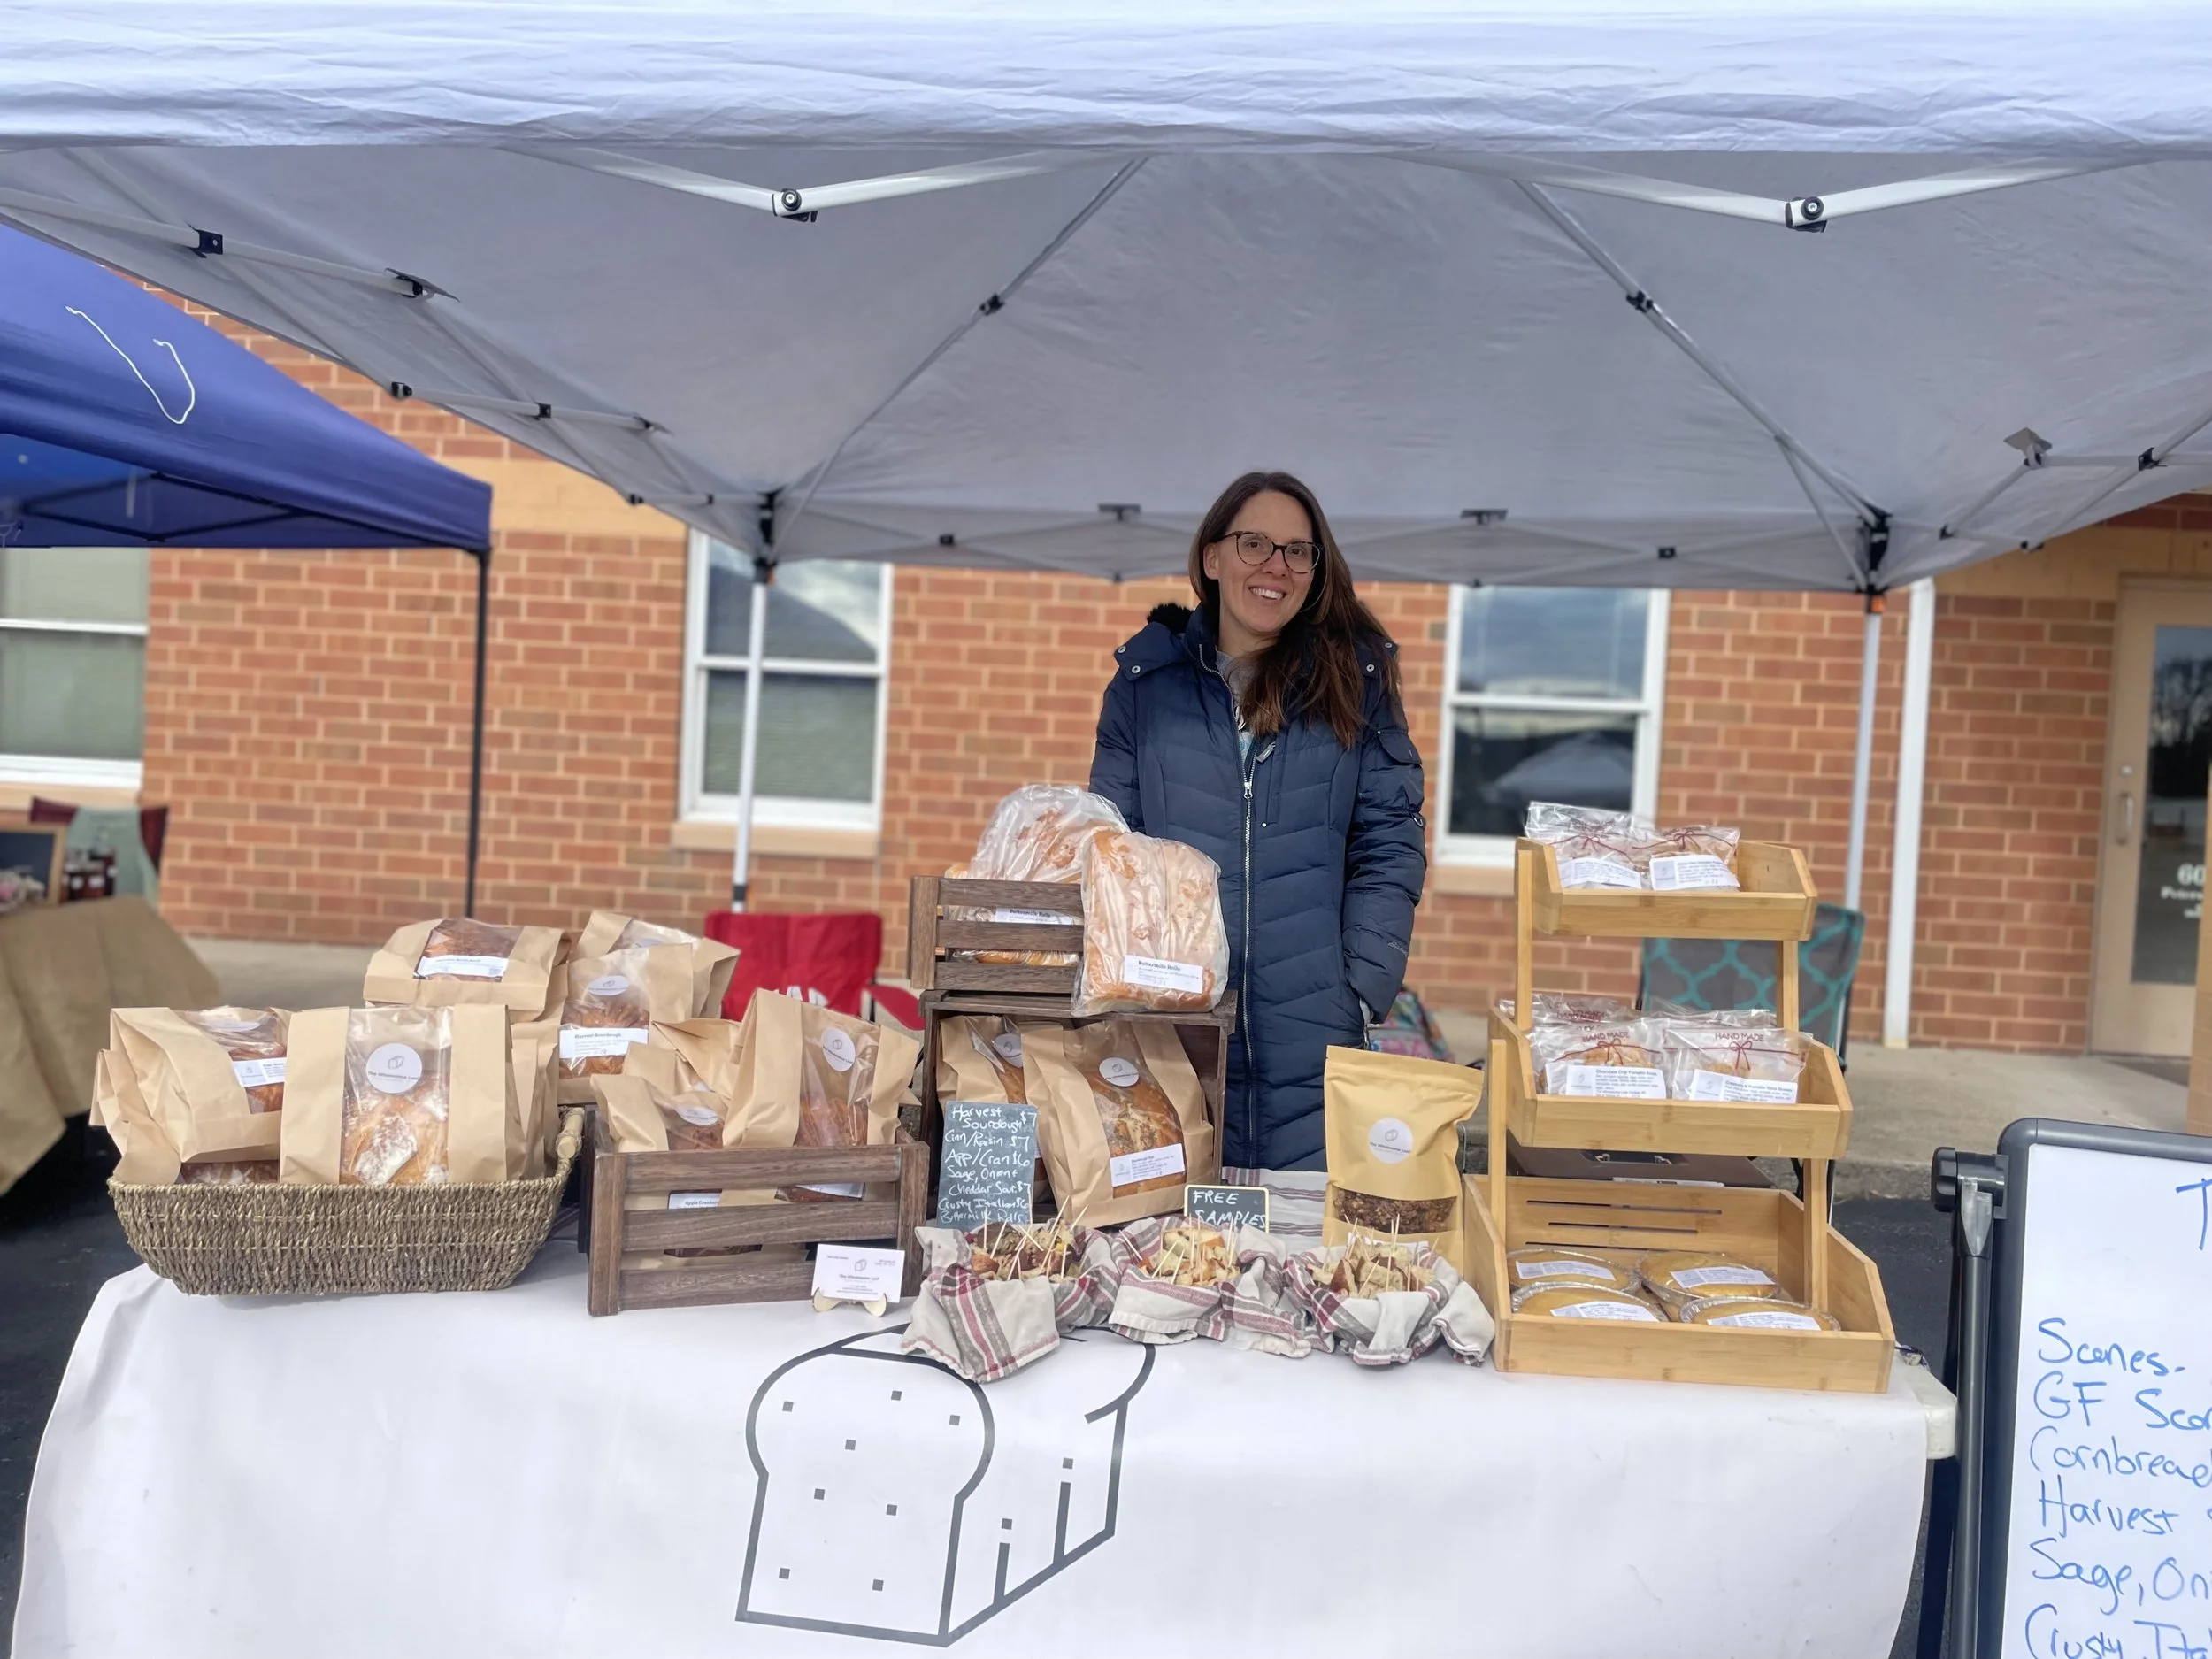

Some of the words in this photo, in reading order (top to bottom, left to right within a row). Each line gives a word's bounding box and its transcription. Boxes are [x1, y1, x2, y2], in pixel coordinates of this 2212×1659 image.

[952, 1105, 1002, 1121] Harvest
[963, 1118, 1022, 1133] Sourdough
[1010, 1136, 1030, 1152] $7
[1012, 1150, 1031, 1167] $6
[949, 1182, 992, 1196] Cheddar
[1193, 1189, 1239, 1204] FREE
[938, 1197, 972, 1213] Crusty
[1194, 1210, 1266, 1228] SAMPLES
[2033, 1371, 2107, 1427] GF
[2039, 1474, 2180, 1538] Harvest
